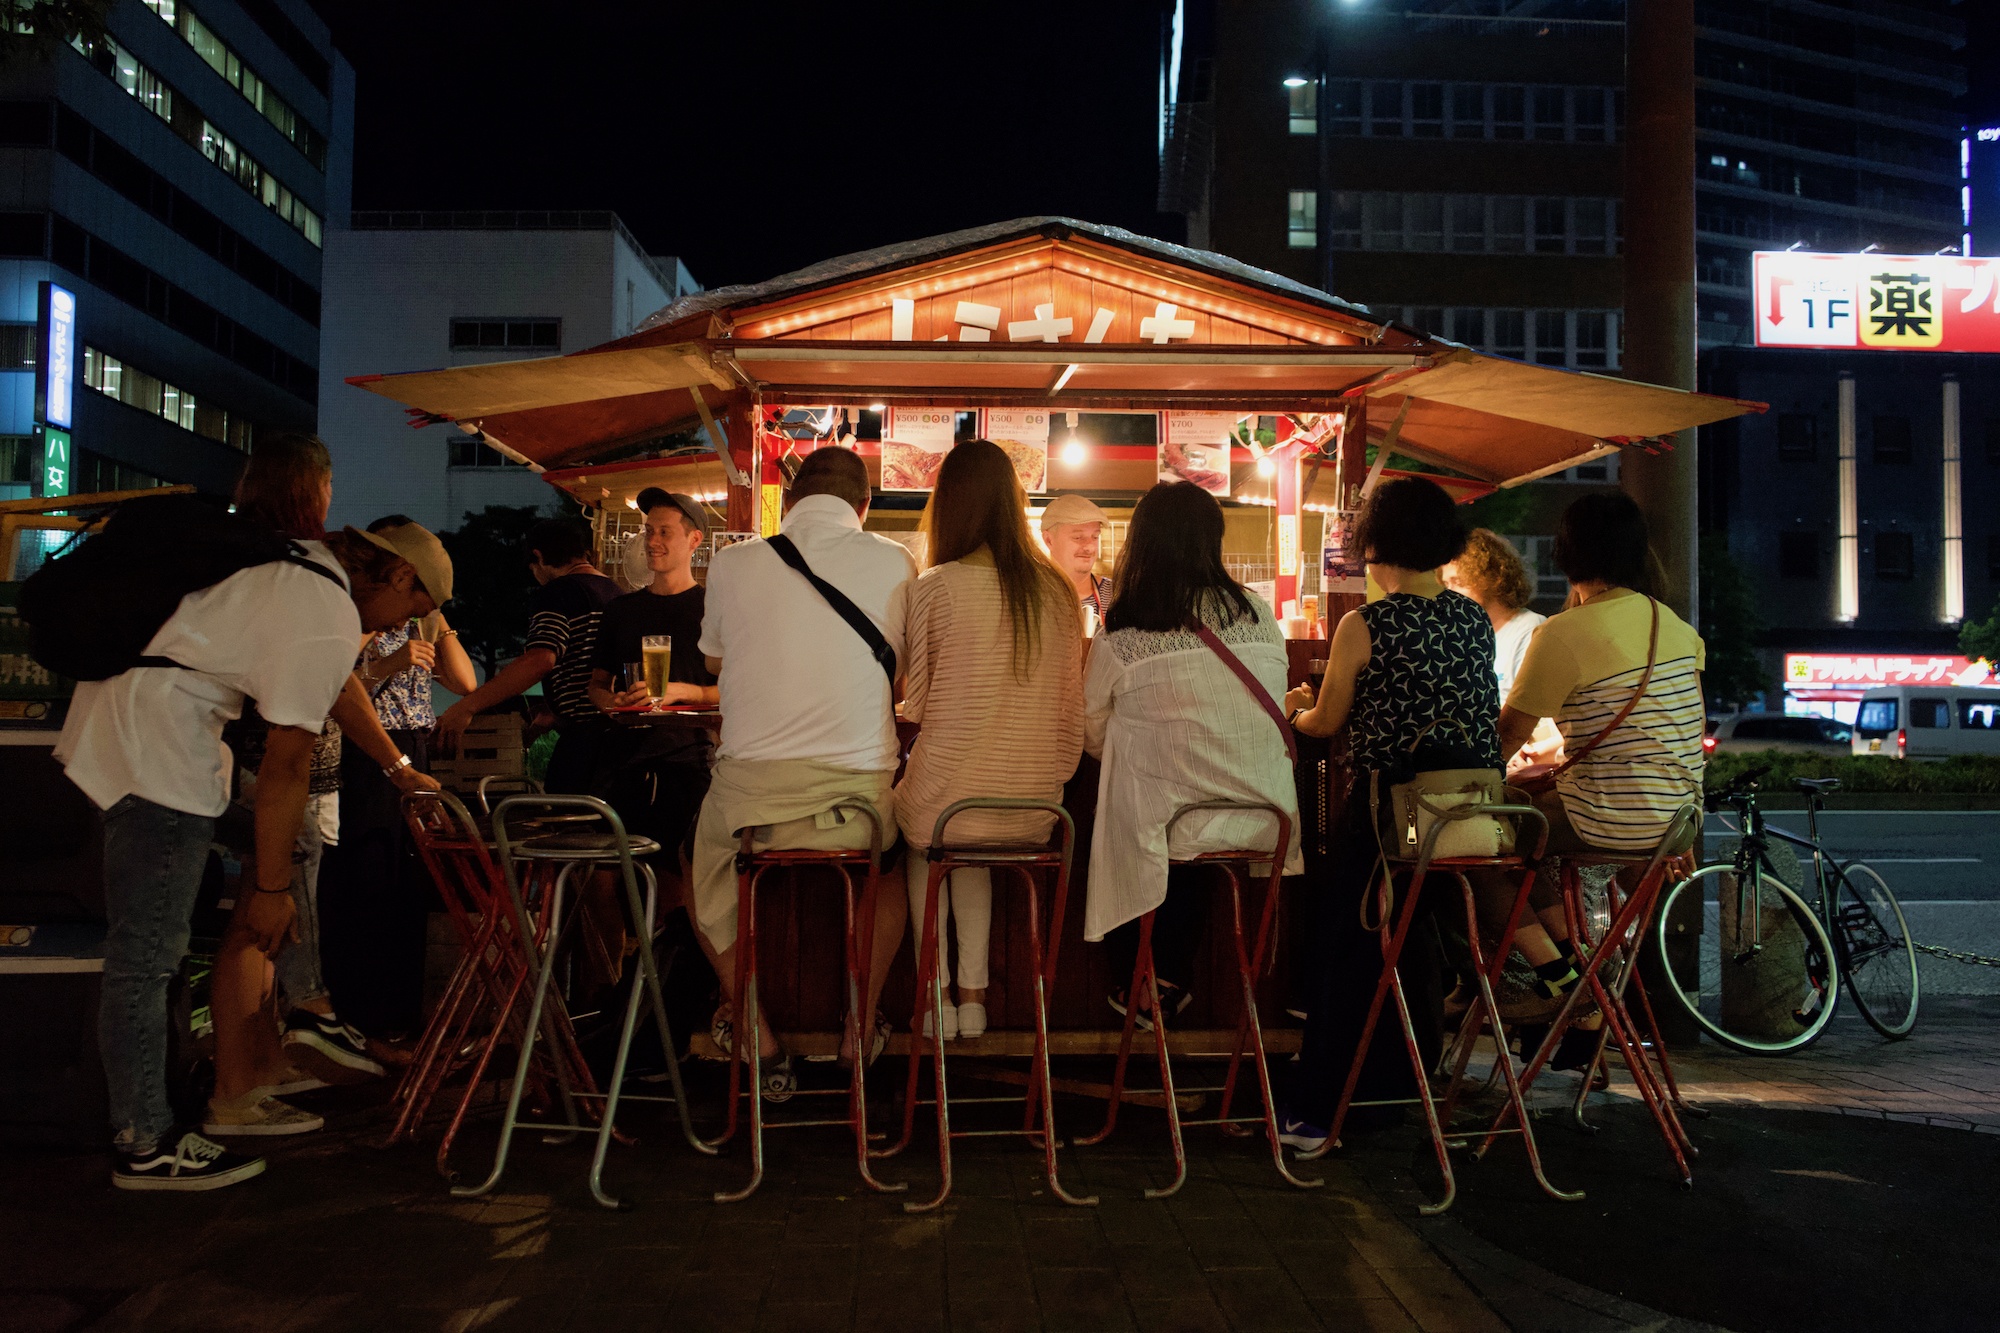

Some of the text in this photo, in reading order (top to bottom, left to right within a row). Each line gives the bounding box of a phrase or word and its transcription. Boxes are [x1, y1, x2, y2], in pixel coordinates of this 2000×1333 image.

[1802, 298, 1850, 329] 1F
[1870, 272, 1932, 336] 薬
[896, 414, 918, 422] ¥500
[1171, 420, 1193, 428] ¥700
